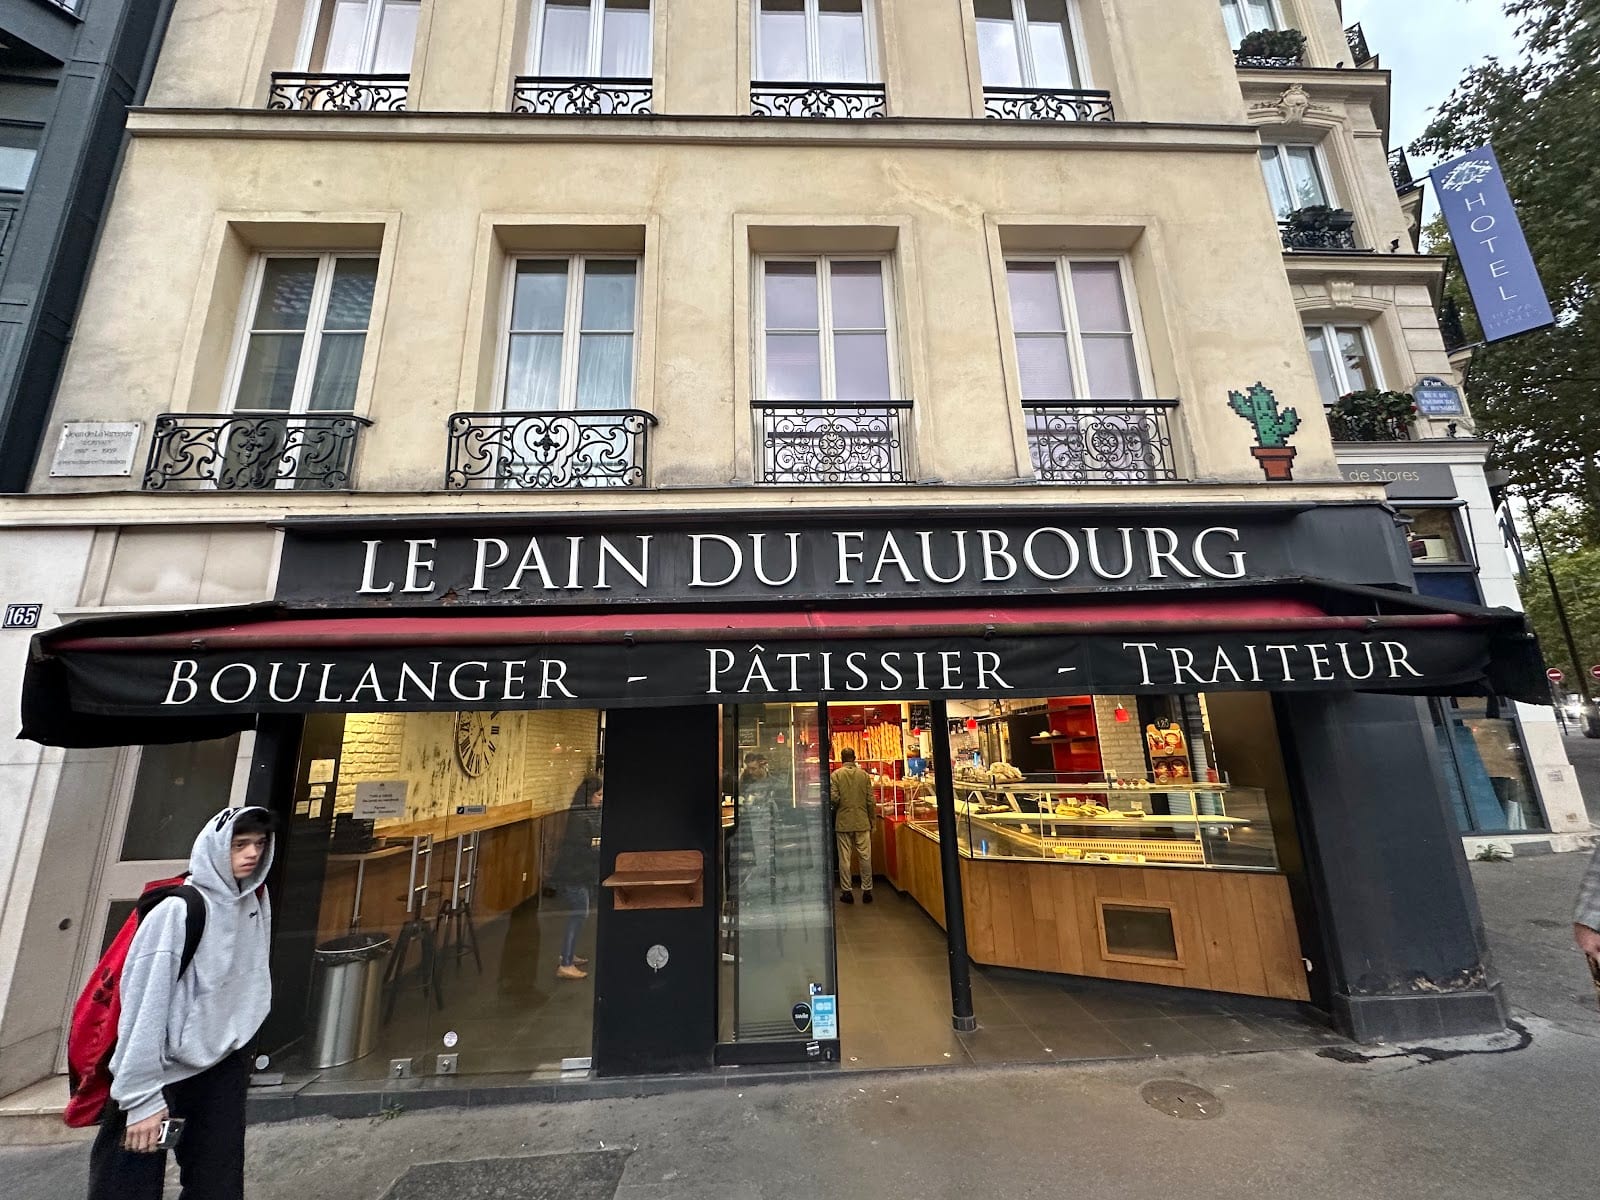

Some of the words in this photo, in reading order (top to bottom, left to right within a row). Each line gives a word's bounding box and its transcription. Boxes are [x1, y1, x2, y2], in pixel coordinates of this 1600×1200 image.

[1464, 192, 1518, 301] HOTEL
[1348, 469, 1370, 481] de
[1373, 468, 1420, 481] Stores
[355, 538, 438, 594] LE
[468, 535, 654, 592] PAIN
[687, 532, 801, 588] DU
[832, 526, 1248, 585] FAUBOURG
[6, 607, 38, 625] 165
[160, 658, 579, 706] BOULANGER
[705, 643, 1015, 694] PÂTISSIER
[1122, 641, 1425, 686] TRAITEUR
